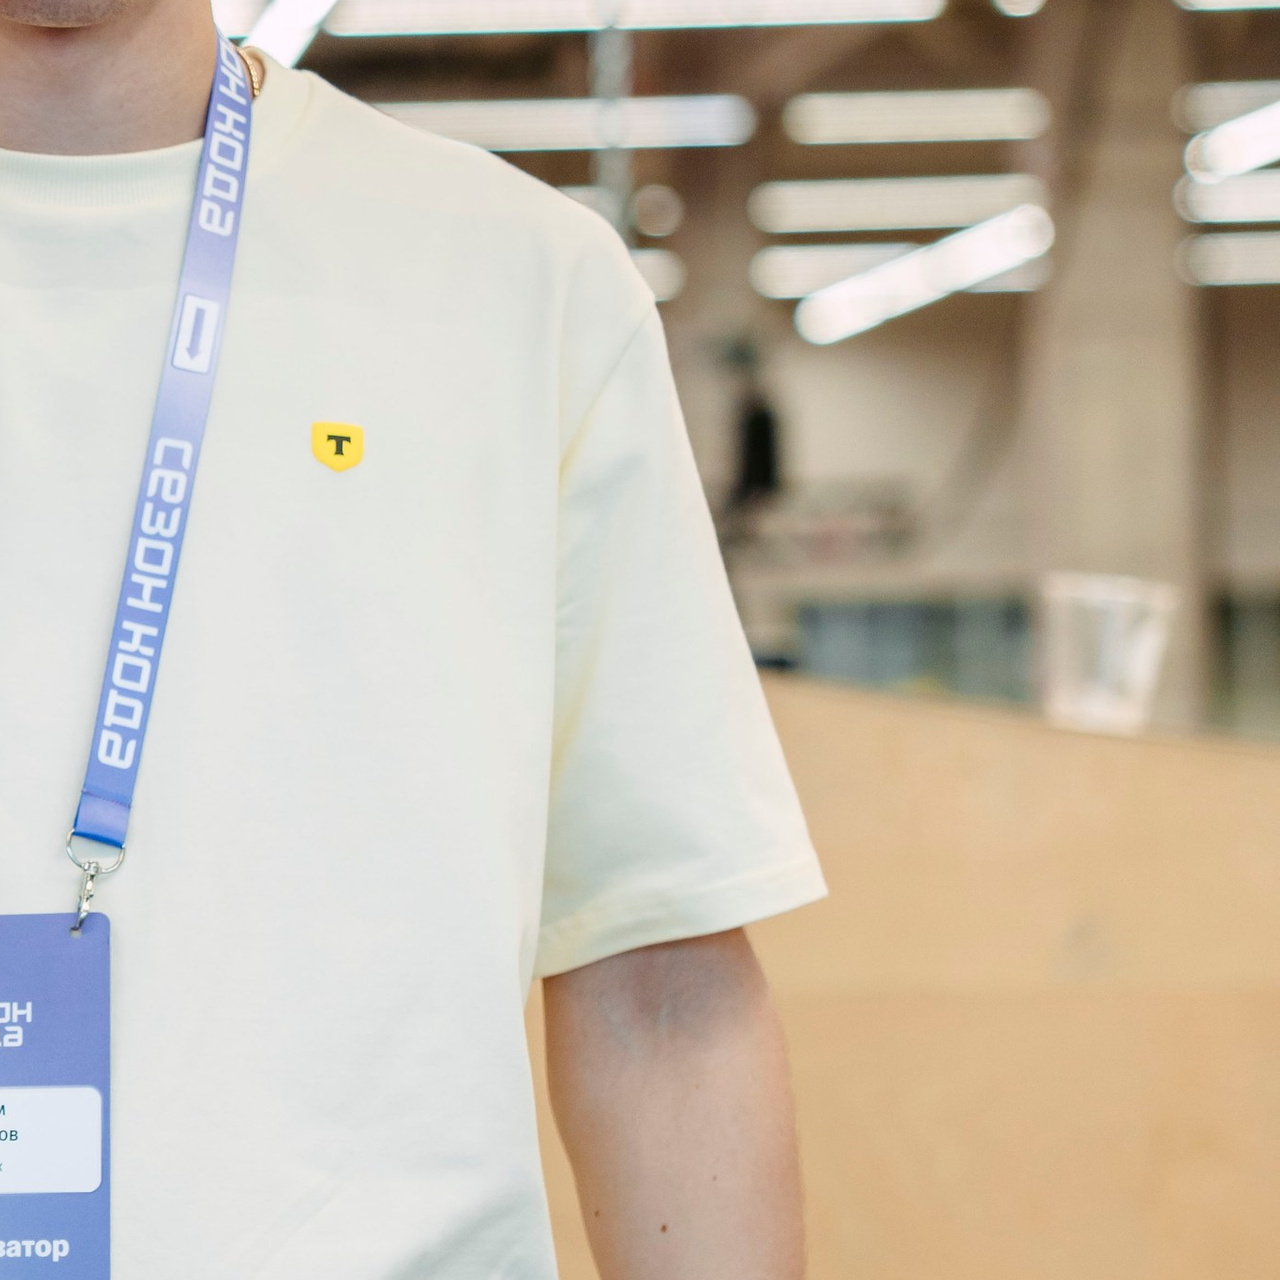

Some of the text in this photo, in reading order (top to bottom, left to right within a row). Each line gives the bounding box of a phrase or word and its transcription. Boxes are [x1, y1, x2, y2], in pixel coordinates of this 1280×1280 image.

[198, 103, 248, 237] кода
[97, 436, 194, 770] сезон кода
